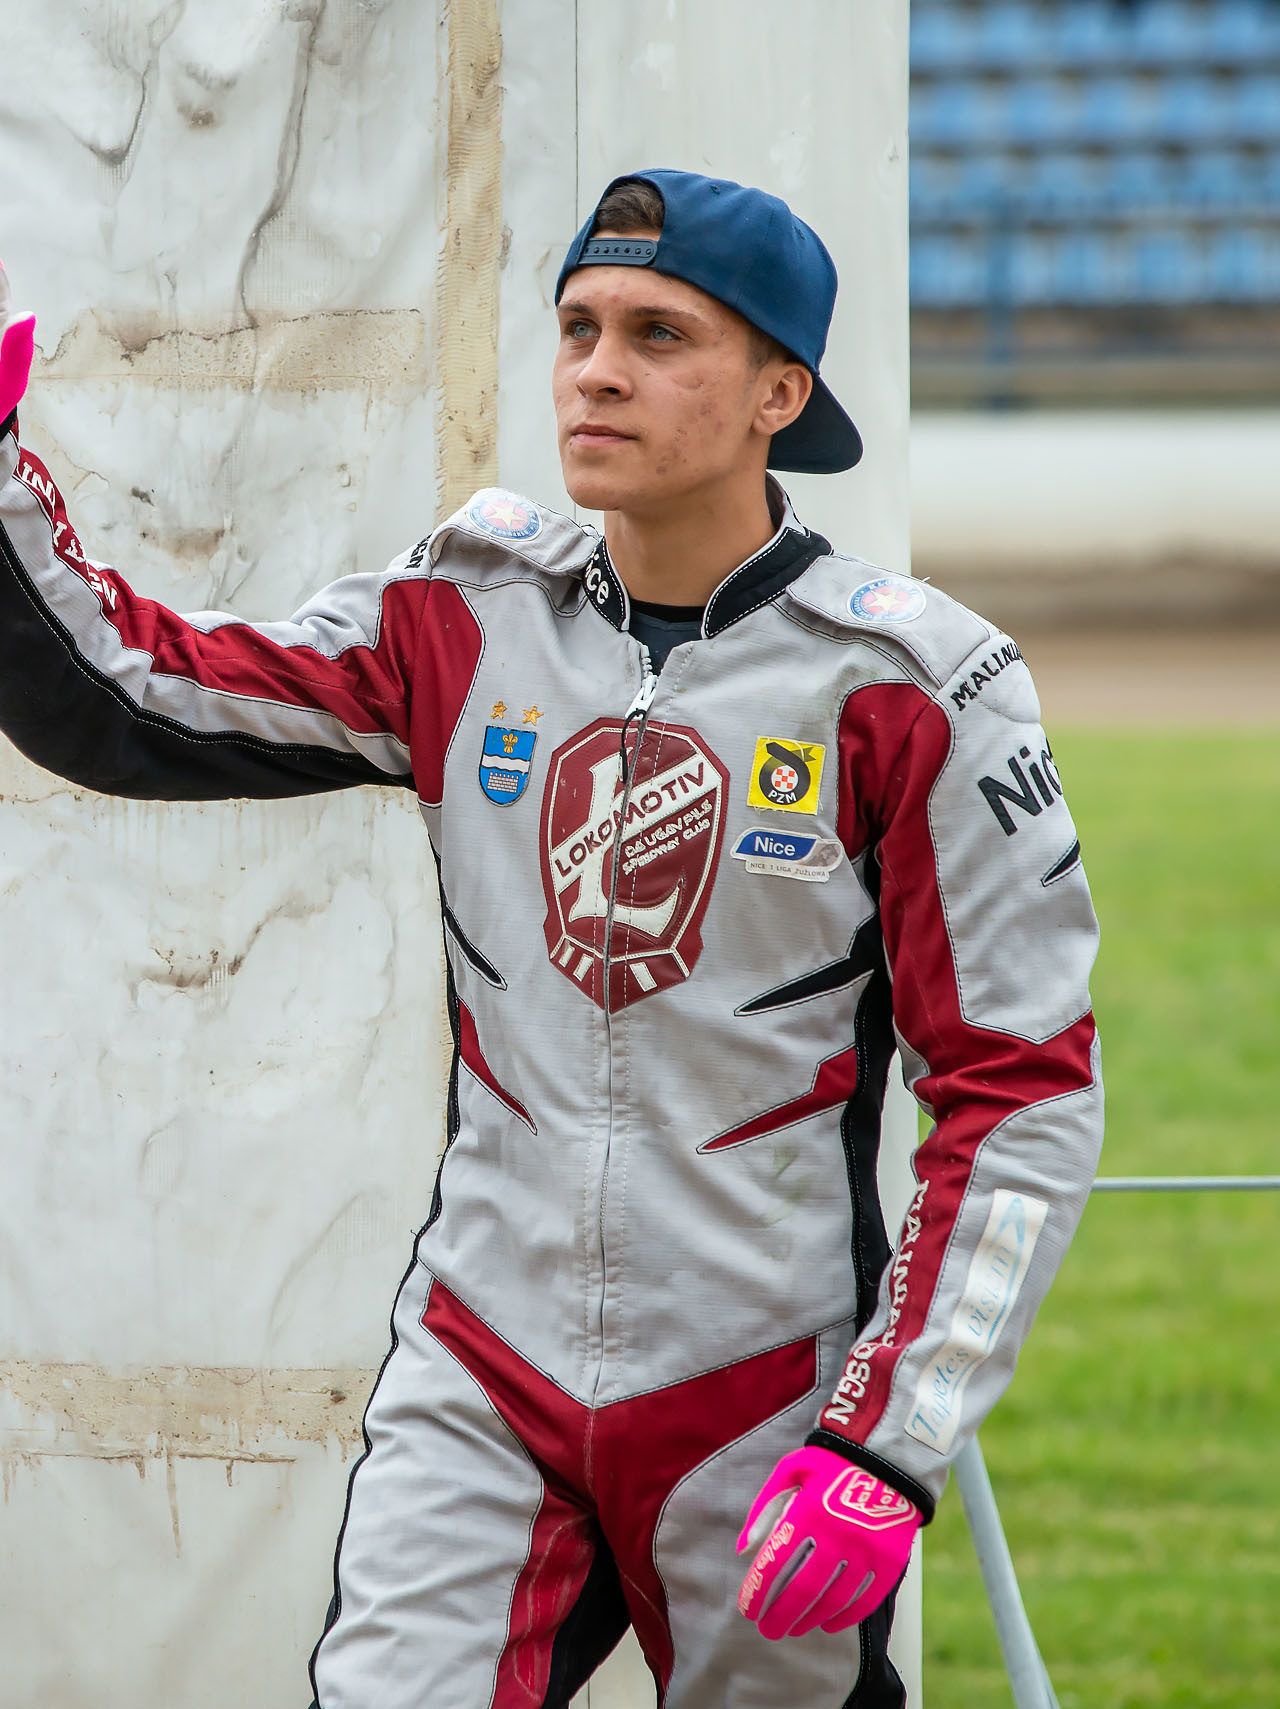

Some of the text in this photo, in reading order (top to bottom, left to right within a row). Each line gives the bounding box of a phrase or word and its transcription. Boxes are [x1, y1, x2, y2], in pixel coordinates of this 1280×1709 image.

[950, 642, 1022, 711] MALIN
[768, 789, 797, 804] PZM
[977, 740, 1063, 837] Nic
[554, 761, 706, 878] LOKOMOTIV
[682, 818, 711, 840] CLUB
[754, 835, 796, 856] Nice
[750, 862, 766, 870] NICE
[776, 865, 793, 873] LIGA
